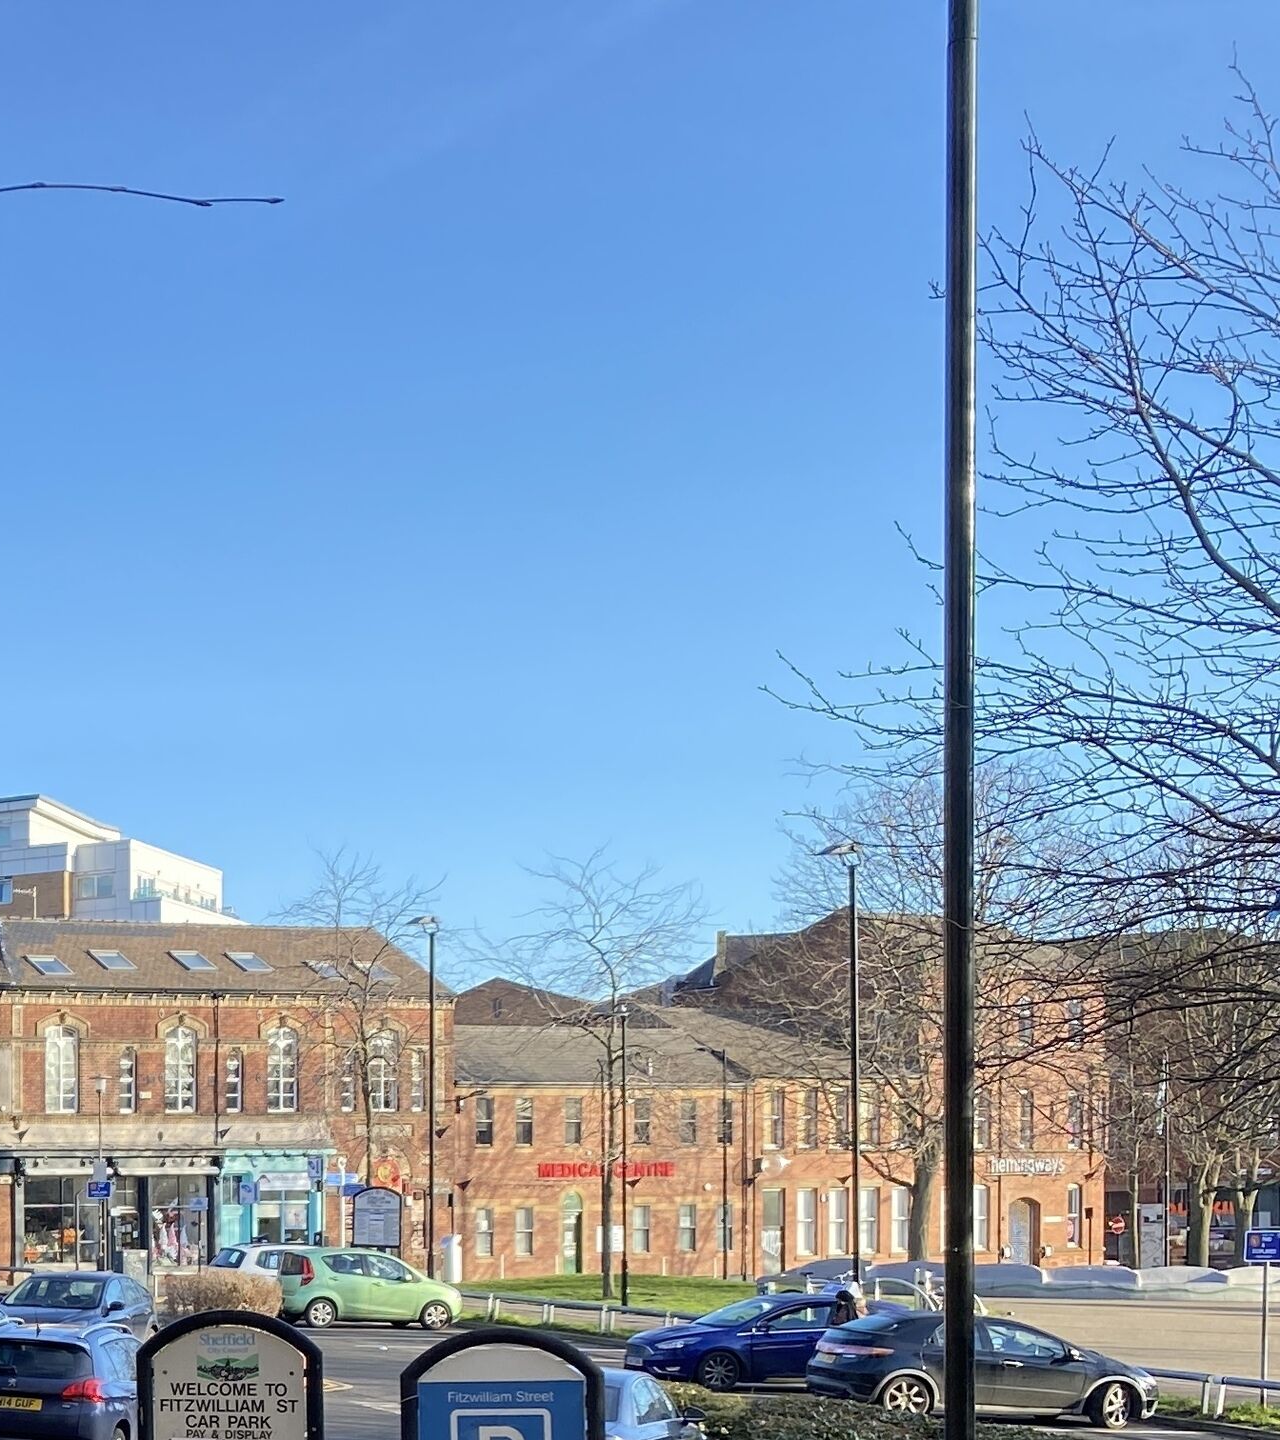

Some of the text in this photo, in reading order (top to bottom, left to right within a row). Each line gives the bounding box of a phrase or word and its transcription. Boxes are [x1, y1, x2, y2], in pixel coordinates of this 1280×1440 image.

[198, 1332, 257, 1346] Sheffield
[170, 1382, 288, 1397] WELCOME TO
[447, 1391, 555, 1403] Fitzwilliam Street
[159, 1399, 299, 1414] FITZWILLIAM ST
[185, 1414, 272, 1430] CAR PARK
[185, 1429, 273, 1440] PAY & DISPLAY
